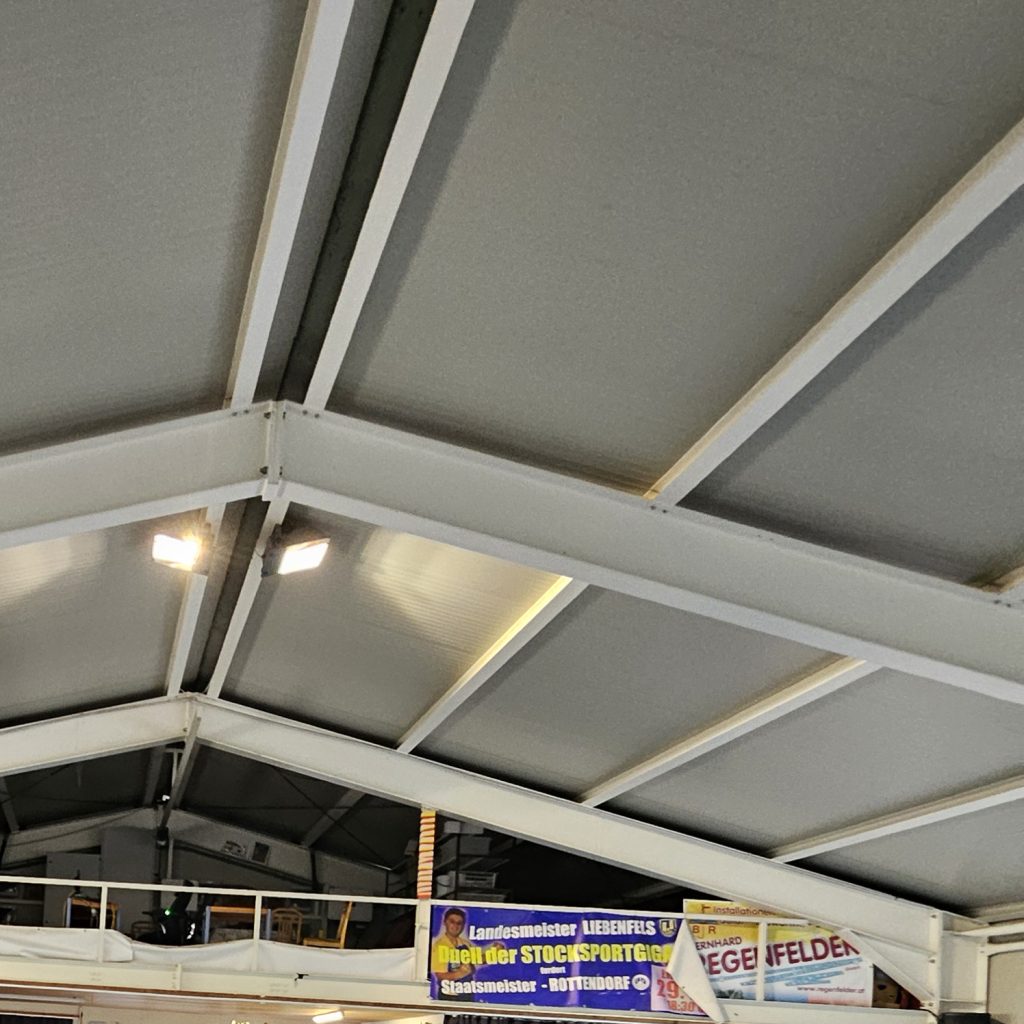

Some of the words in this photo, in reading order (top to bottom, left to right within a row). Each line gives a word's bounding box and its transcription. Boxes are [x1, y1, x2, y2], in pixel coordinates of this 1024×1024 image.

[469, 922, 578, 940] Landesmeister
[582, 919, 657, 936] LIEBENFELS
[437, 945, 482, 965] Duell
[485, 945, 518, 965] der
[520, 943, 674, 964] STOCKSPORTGIGA
[695, 936, 743, 951] ERNHARD
[700, 935, 860, 976] EGENFELDER
[440, 979, 537, 995] Staatsmeister
[548, 976, 631, 993] ROTTENDORF
